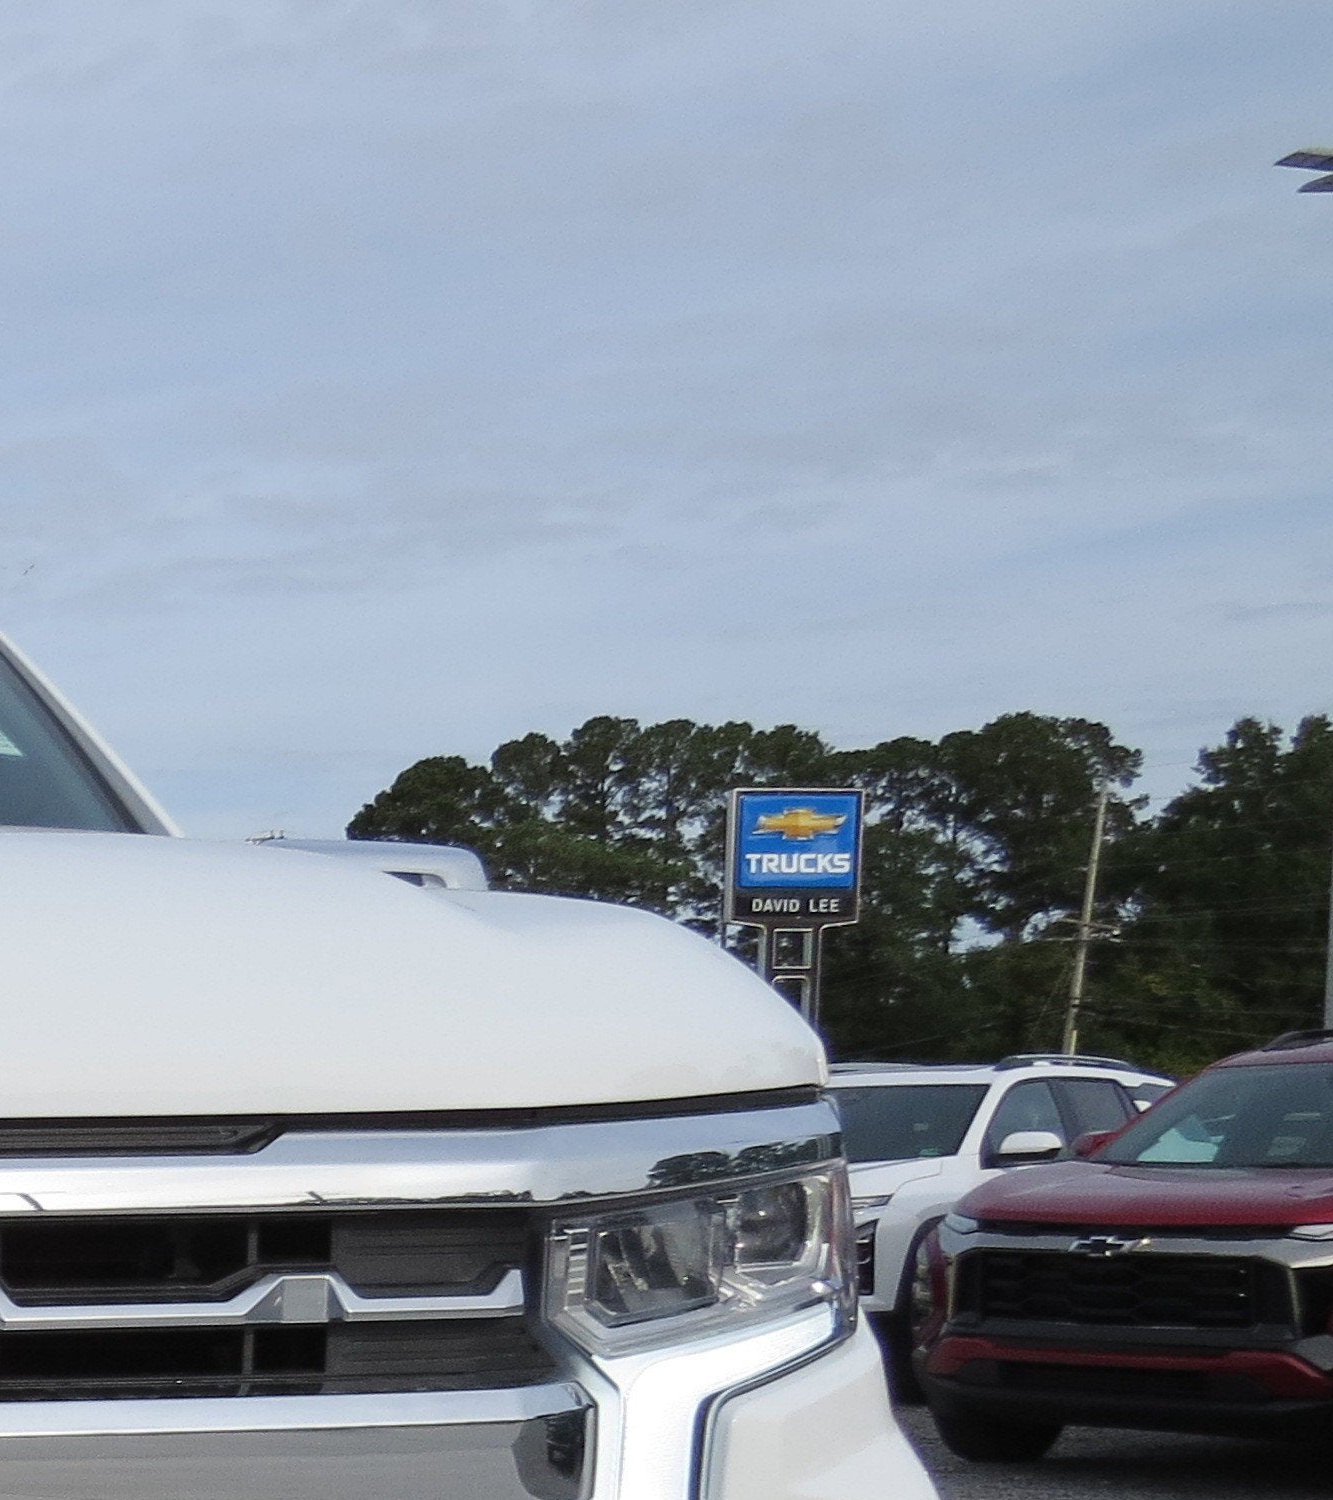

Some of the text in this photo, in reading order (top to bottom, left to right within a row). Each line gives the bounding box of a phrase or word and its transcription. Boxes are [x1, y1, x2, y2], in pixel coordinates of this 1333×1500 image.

[745, 853, 850, 873] TRUCKS
[752, 899, 840, 912] DAVID LEE
